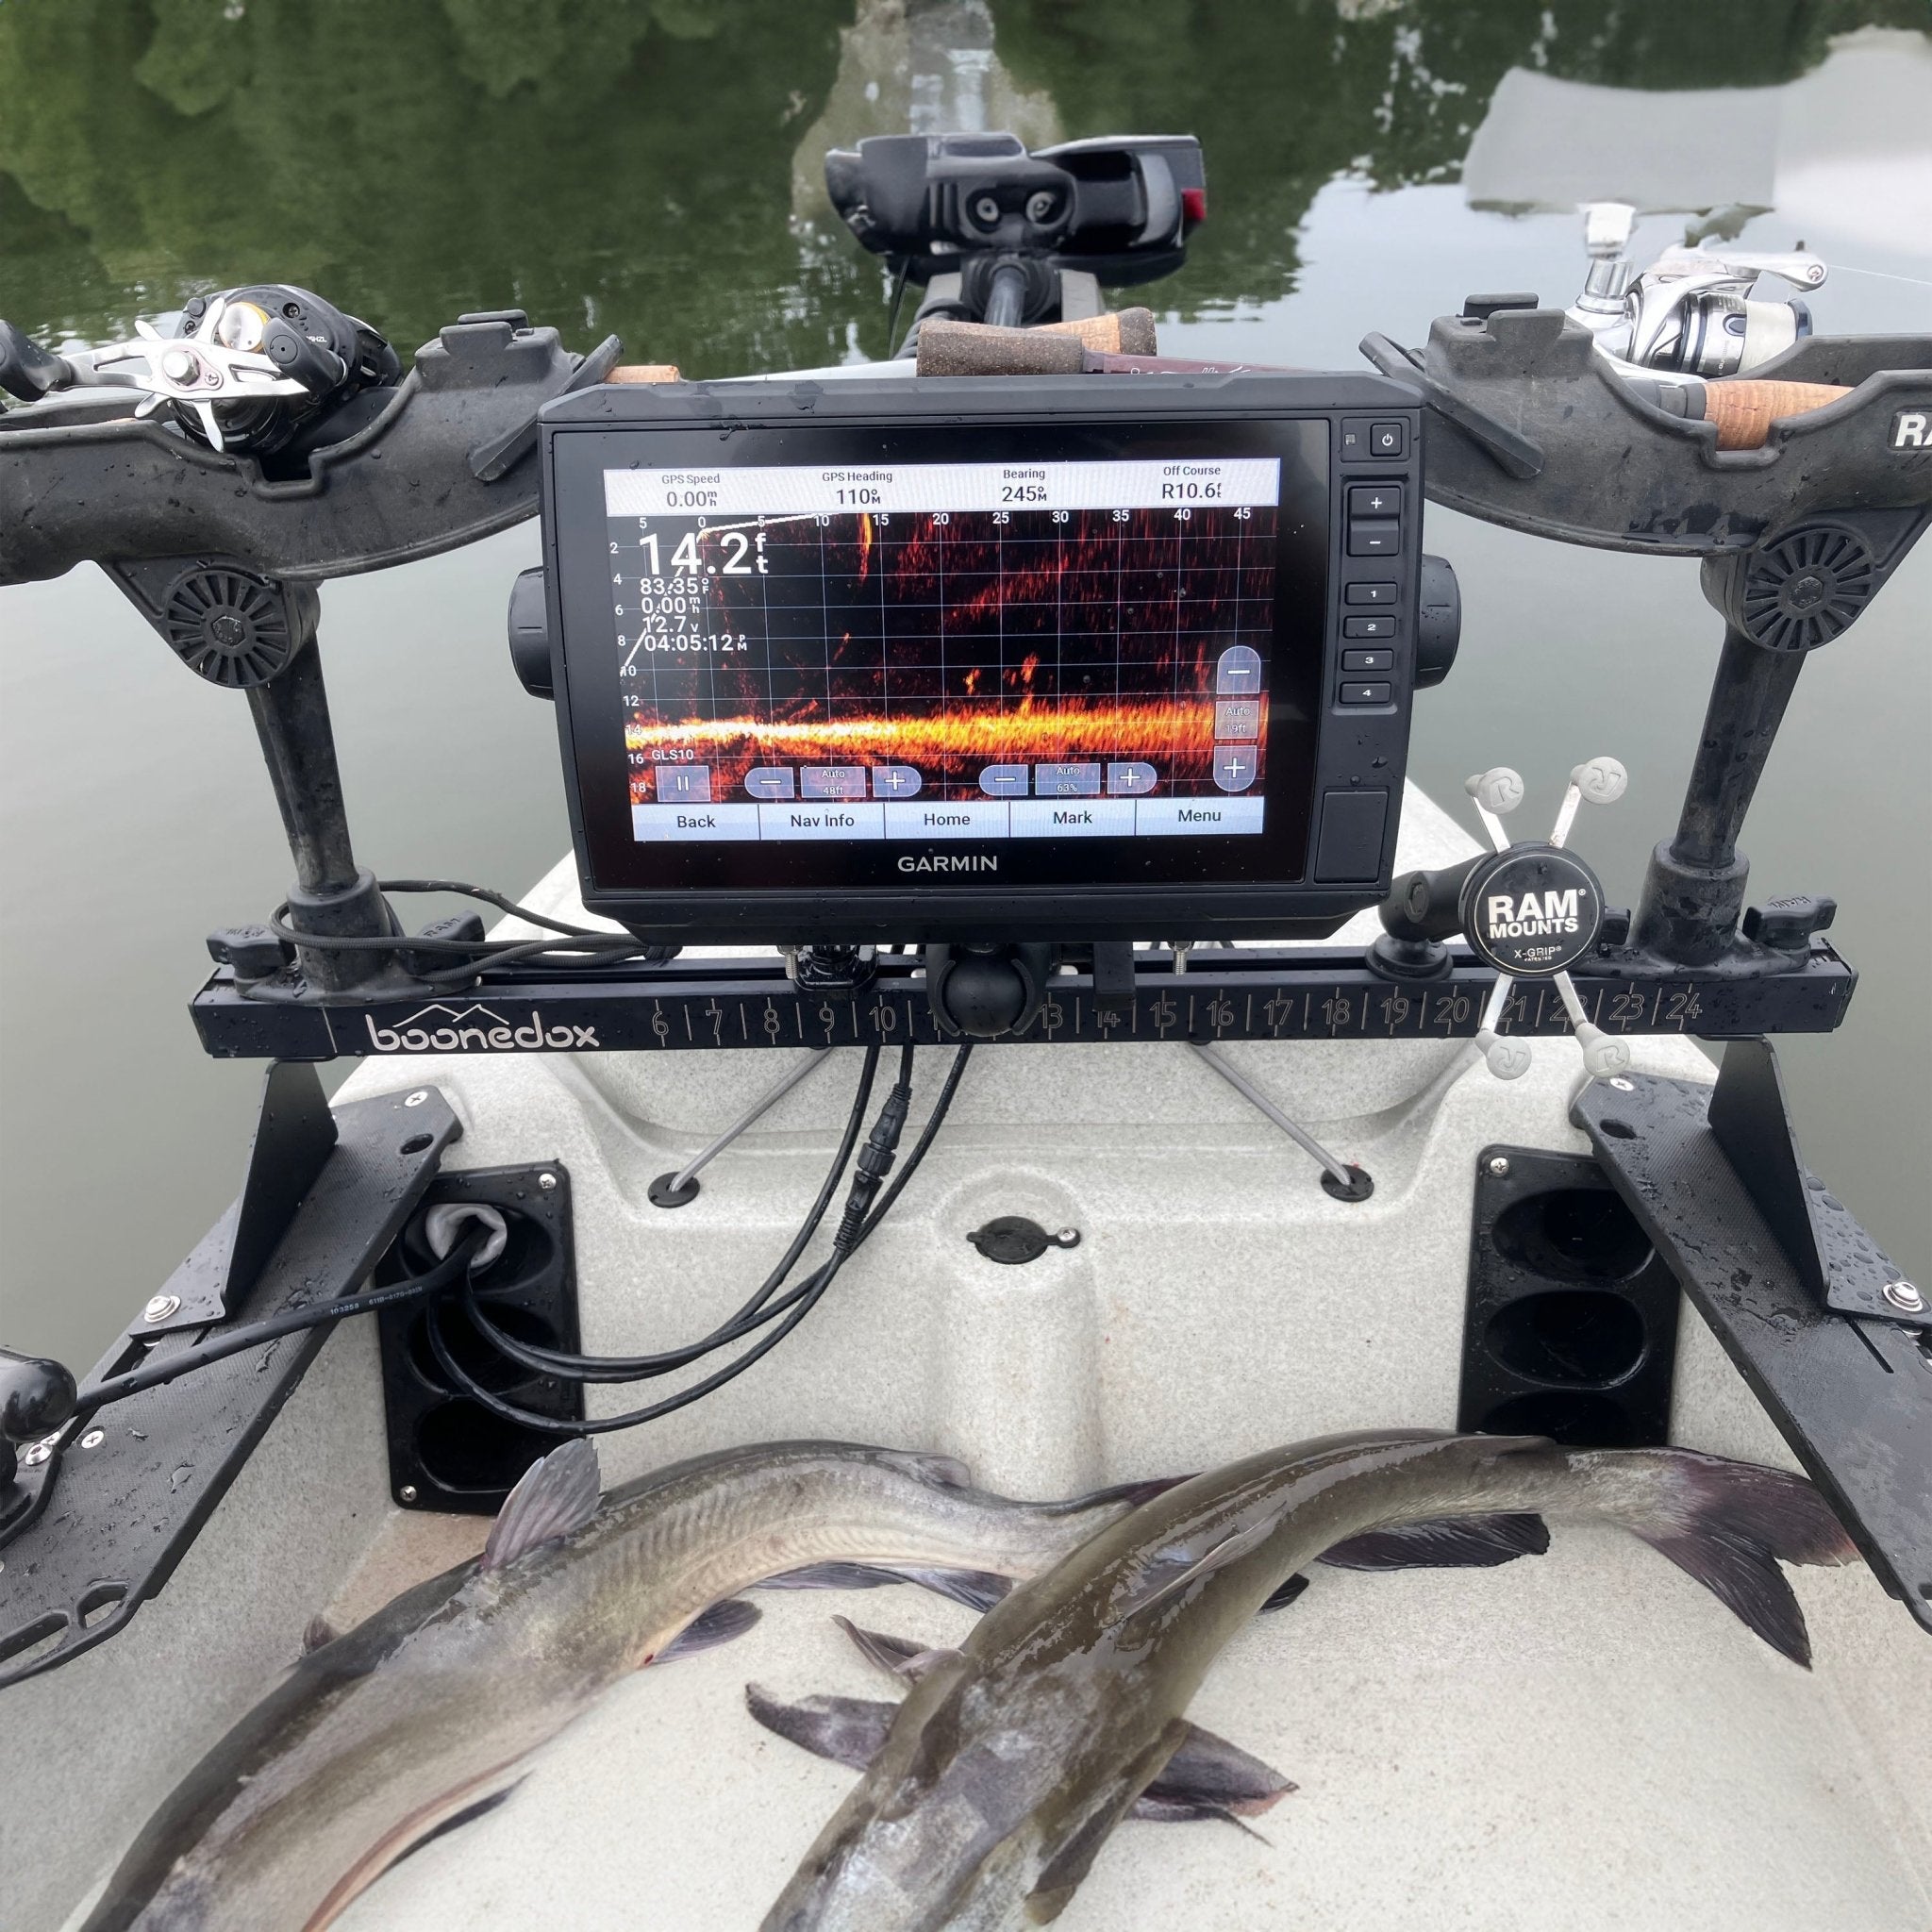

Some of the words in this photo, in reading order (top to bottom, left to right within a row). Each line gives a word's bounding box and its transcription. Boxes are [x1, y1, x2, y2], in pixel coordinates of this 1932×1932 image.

[1895, 415, 1932, 446] R
[1003, 469, 1046, 480] Bearing
[1163, 466, 1180, 475] Off
[1183, 466, 1221, 475] Course
[661, 475, 684, 484] GPS
[687, 474, 720, 486] Speed
[822, 473, 845, 482] GPS
[847, 471, 893, 485] Heading
[815, 514, 830, 526] 10
[874, 513, 890, 525] 15
[932, 512, 949, 525] 20
[992, 511, 1009, 525] 25
[1052, 510, 1069, 524] 30
[1112, 509, 1129, 523] 35
[1174, 508, 1191, 522] 40
[1234, 508, 1251, 520] 45
[639, 517, 648, 528] 5
[698, 516, 707, 528] 0
[610, 541, 619, 555] 2
[613, 573, 623, 585] 4
[615, 604, 624, 616] 6
[617, 635, 626, 646] 8
[644, 634, 734, 652] 04:05:12
[1362, 689, 1372, 697] 4
[623, 694, 640, 707] 12
[1225, 707, 1250, 717] Auto
[625, 724, 641, 736] 14
[627, 753, 644, 765] 16
[652, 749, 694, 760] GLS10
[821, 770, 845, 779] Auto
[1056, 767, 1080, 776] Auto
[630, 782, 646, 793] 18
[823, 786, 844, 796] 48ft
[1057, 783, 1077, 793] 63%
[676, 815, 716, 829] Back
[790, 815, 821, 828] Nav
[825, 814, 855, 827] Info
[924, 813, 971, 826] Home
[1053, 811, 1092, 824] Mark
[1178, 809, 1222, 823] Menu
[897, 856, 998, 873] GARMIN
[1489, 917, 1579, 940] MOUNTS
[1207, 1000, 1235, 1026] 16
[1263, 999, 1293, 1026] 17
[1321, 998, 1350, 1025] 18
[1380, 997, 1409, 1024] 19
[1434, 996, 1471, 1024] 20
[1608, 993, 1645, 1022] 23
[1666, 992, 1703, 1020] 24
[763, 1008, 780, 1034] 8
[819, 1007, 835, 1033] 9
[869, 1006, 896, 1032] 10
[1039, 1003, 1063, 1029] 13
[1149, 1001, 1176, 1028] 15
[652, 1010, 669, 1036] 6
[705, 1009, 723, 1035] 7
[365, 1010, 600, 1051] boonedox
